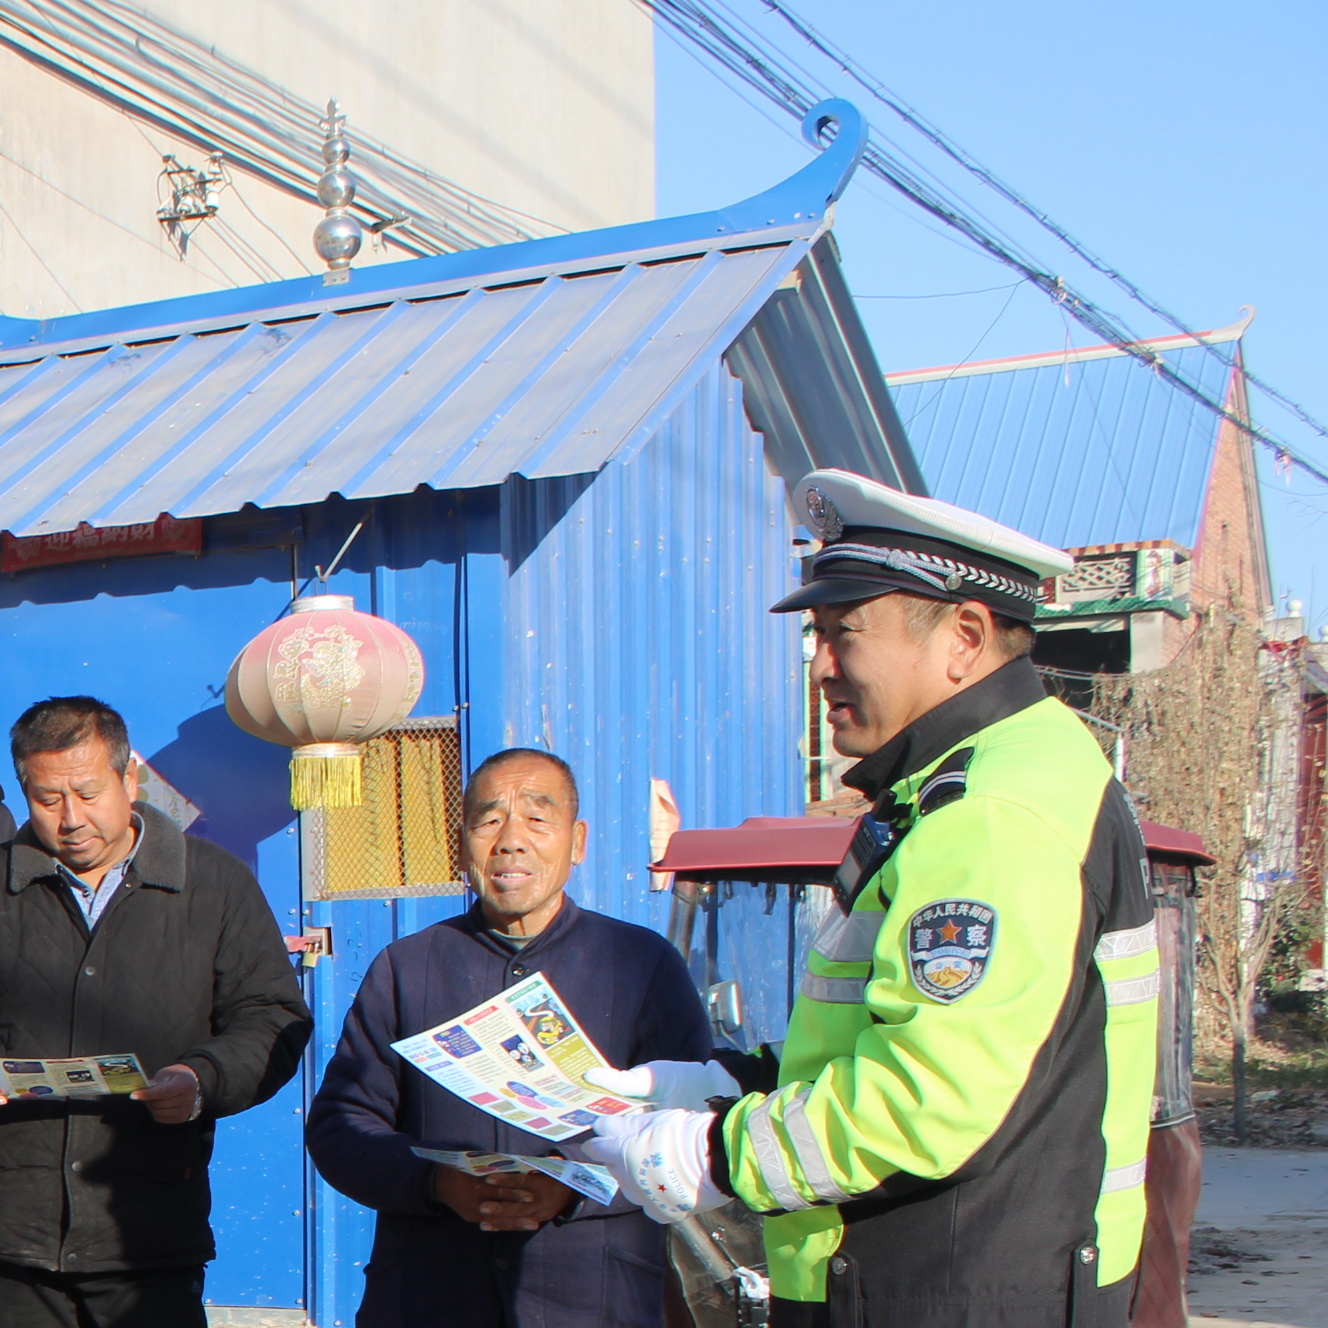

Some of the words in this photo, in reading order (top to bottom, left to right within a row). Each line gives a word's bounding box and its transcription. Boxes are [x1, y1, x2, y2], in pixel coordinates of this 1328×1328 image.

[912, 903, 994, 928] 中华人民共和国
